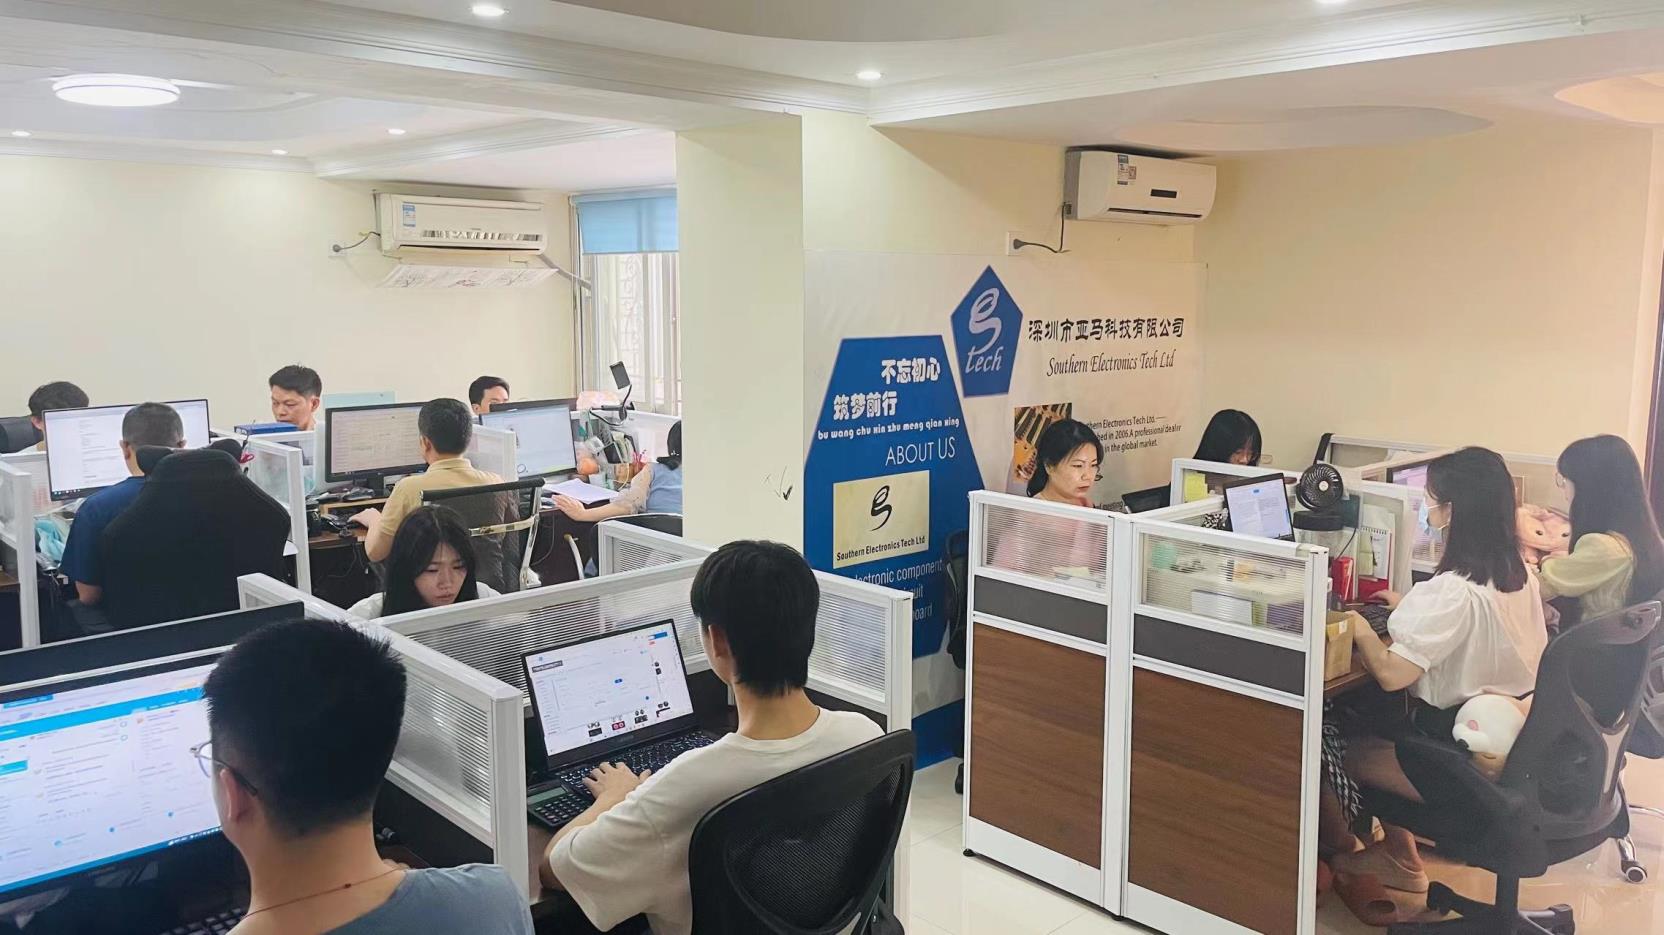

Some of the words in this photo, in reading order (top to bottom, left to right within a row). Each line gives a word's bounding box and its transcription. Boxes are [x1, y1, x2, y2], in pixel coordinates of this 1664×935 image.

[1028, 317, 1185, 343] 深圳市亚马科技有限公司
[881, 357, 941, 384] 不忘初心
[965, 346, 1004, 374] tech
[1047, 354, 1088, 377] Southern
[1090, 352, 1138, 373] Electronics
[1139, 352, 1158, 369] Tech
[1159, 349, 1177, 368] Ltd
[833, 391, 898, 420] 筑梦前行
[818, 430, 829, 440] bu
[831, 429, 854, 440] wang
[856, 425, 871, 436] chu
[873, 424, 886, 434] xin
[887, 422, 901, 433] zhu
[903, 421, 924, 432] meng
[925, 419, 943, 430] qian
[944, 416, 960, 428] xing
[1103, 419, 1132, 428] Electronics
[1133, 416, 1145, 424] Tech
[1108, 432, 1114, 440] in
[1134, 425, 1164, 438] professional
[885, 441, 934, 466] ABOUT
[938, 436, 956, 460] US
[1111, 442, 1120, 451] the
[1121, 440, 1138, 453] global
[836, 548, 865, 561] Southern
[866, 541, 900, 555] Electronics
[901, 537, 915, 548] Tech
[916, 536, 925, 545] Ltd
